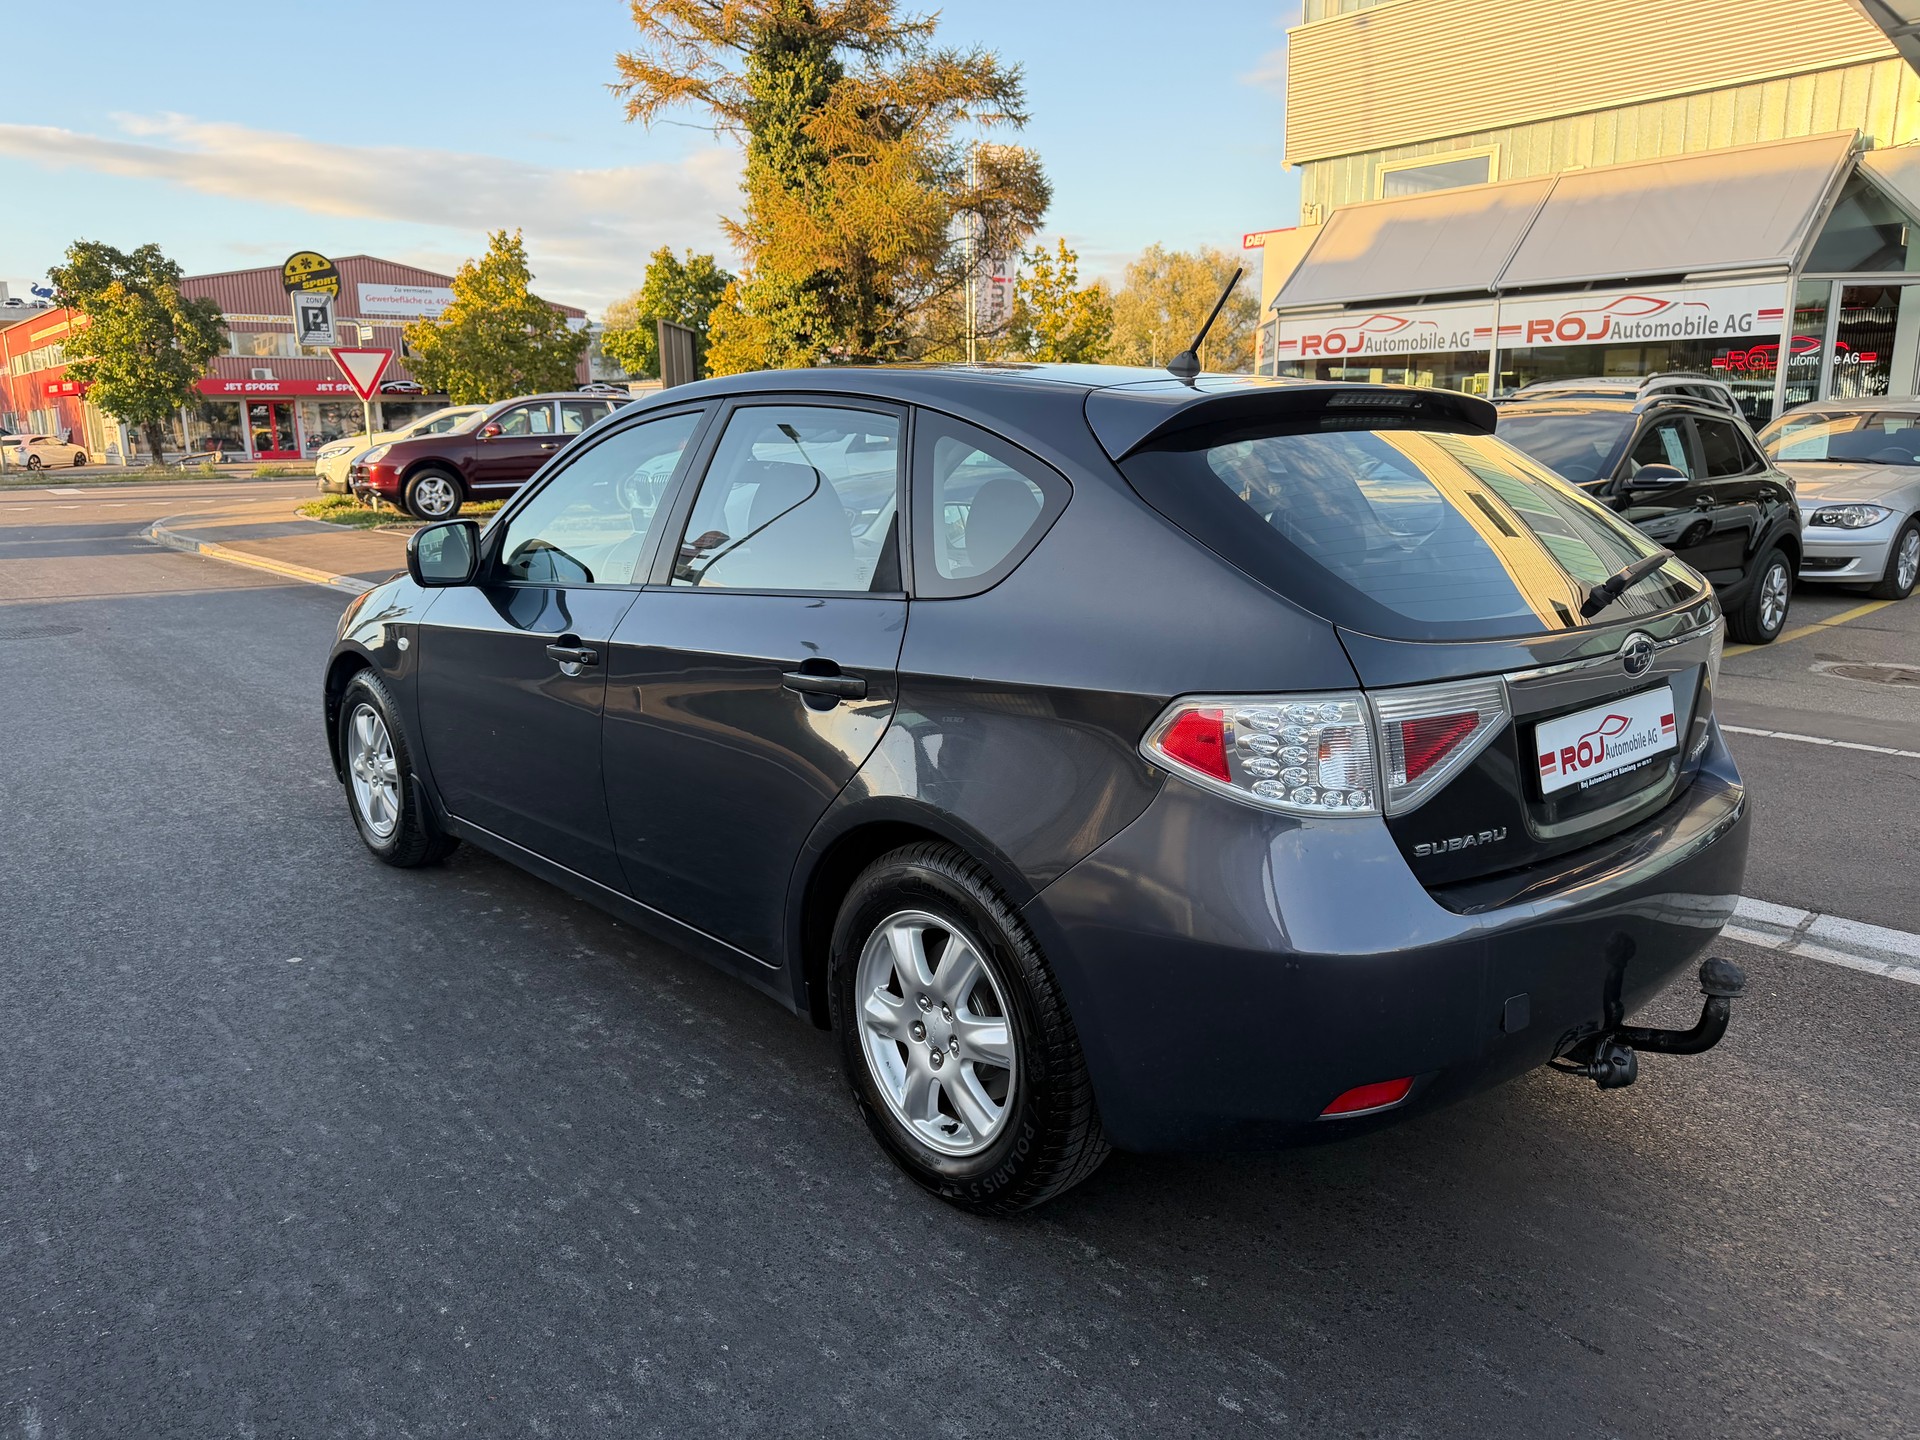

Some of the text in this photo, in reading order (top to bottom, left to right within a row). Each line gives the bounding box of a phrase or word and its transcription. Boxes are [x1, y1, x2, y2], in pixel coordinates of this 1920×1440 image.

[302, 275, 338, 289] SPORT
[305, 296, 323, 304] ZONE
[365, 294, 422, 305] Gewerbefläche
[1526, 313, 1752, 343] ROJ Automobile AG
[1301, 331, 1470, 356] ROJ Automobile AG
[1843, 352, 1860, 364] AG
[223, 382, 280, 391] JET SPORT
[316, 383, 334, 391] JET
[1560, 728, 1658, 775] ROJ Automobile AG
[1413, 826, 1507, 858] SUBARU
[970, 1122, 1035, 1198] POLARIS 5
